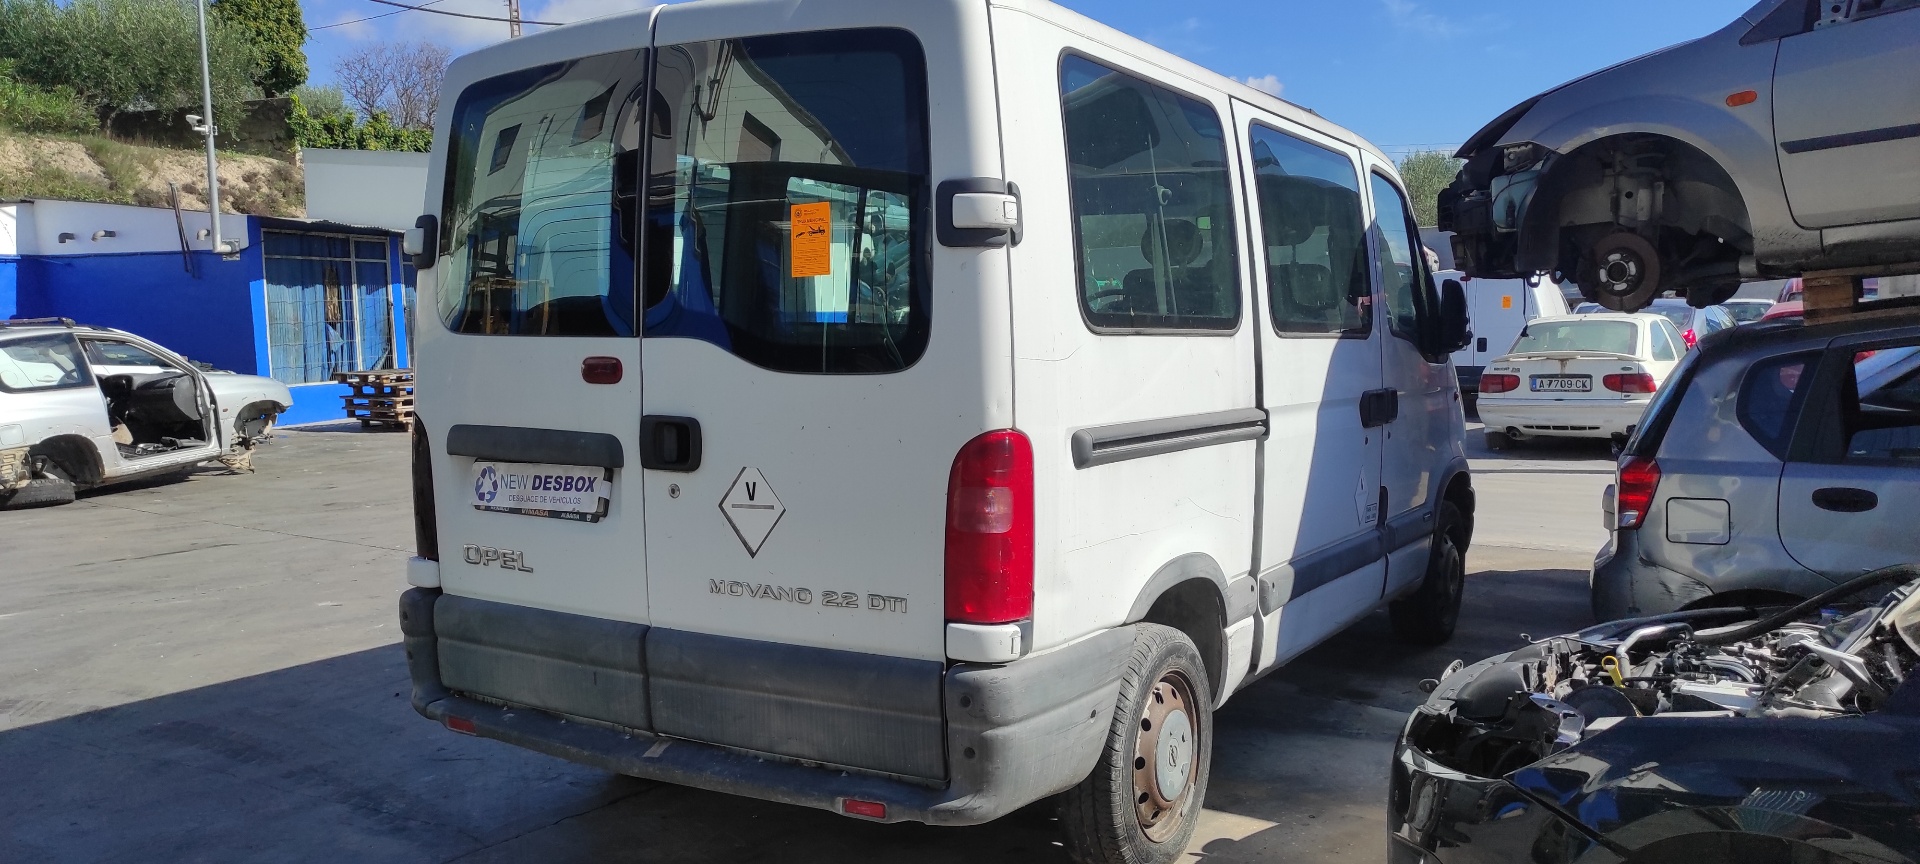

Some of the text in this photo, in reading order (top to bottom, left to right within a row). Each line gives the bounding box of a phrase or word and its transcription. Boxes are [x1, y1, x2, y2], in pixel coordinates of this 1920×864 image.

[500, 473, 598, 493] NEW DESBOX
[745, 481, 757, 501] V
[508, 494, 538, 503] DESGUACE
[521, 508, 549, 517] VIMASA
[463, 544, 534, 573] OPEL
[709, 578, 908, 613] MOVANO 2.2 DTI
